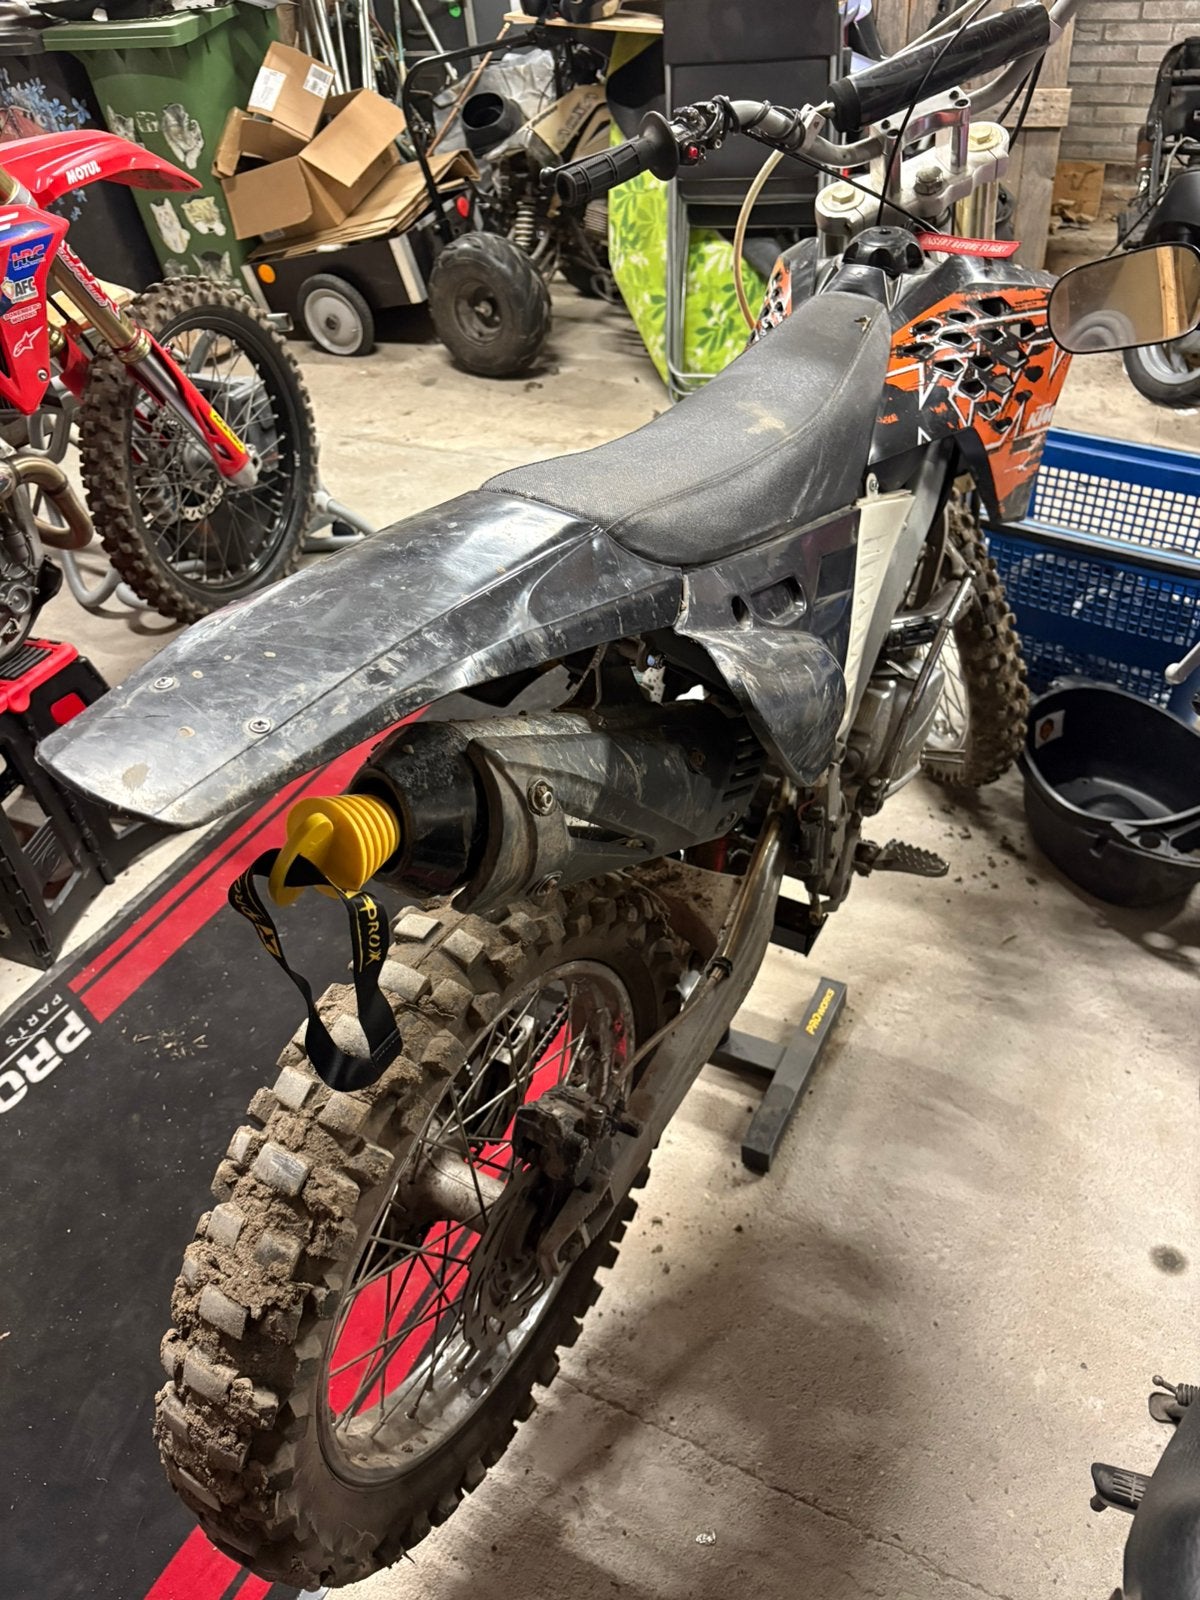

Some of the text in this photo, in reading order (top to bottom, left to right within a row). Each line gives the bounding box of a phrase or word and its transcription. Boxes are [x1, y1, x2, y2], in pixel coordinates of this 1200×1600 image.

[66, 160, 102, 185] MOTUL
[12, 244, 45, 268] HRC
[951, 239, 980, 251] BEFORE
[979, 243, 1009, 253] FLIGHT
[14, 278, 36, 297] AFC
[1026, 402, 1056, 429] KTM
[359, 895, 382, 965] PROX
[5, 993, 63, 1047] PARTS
